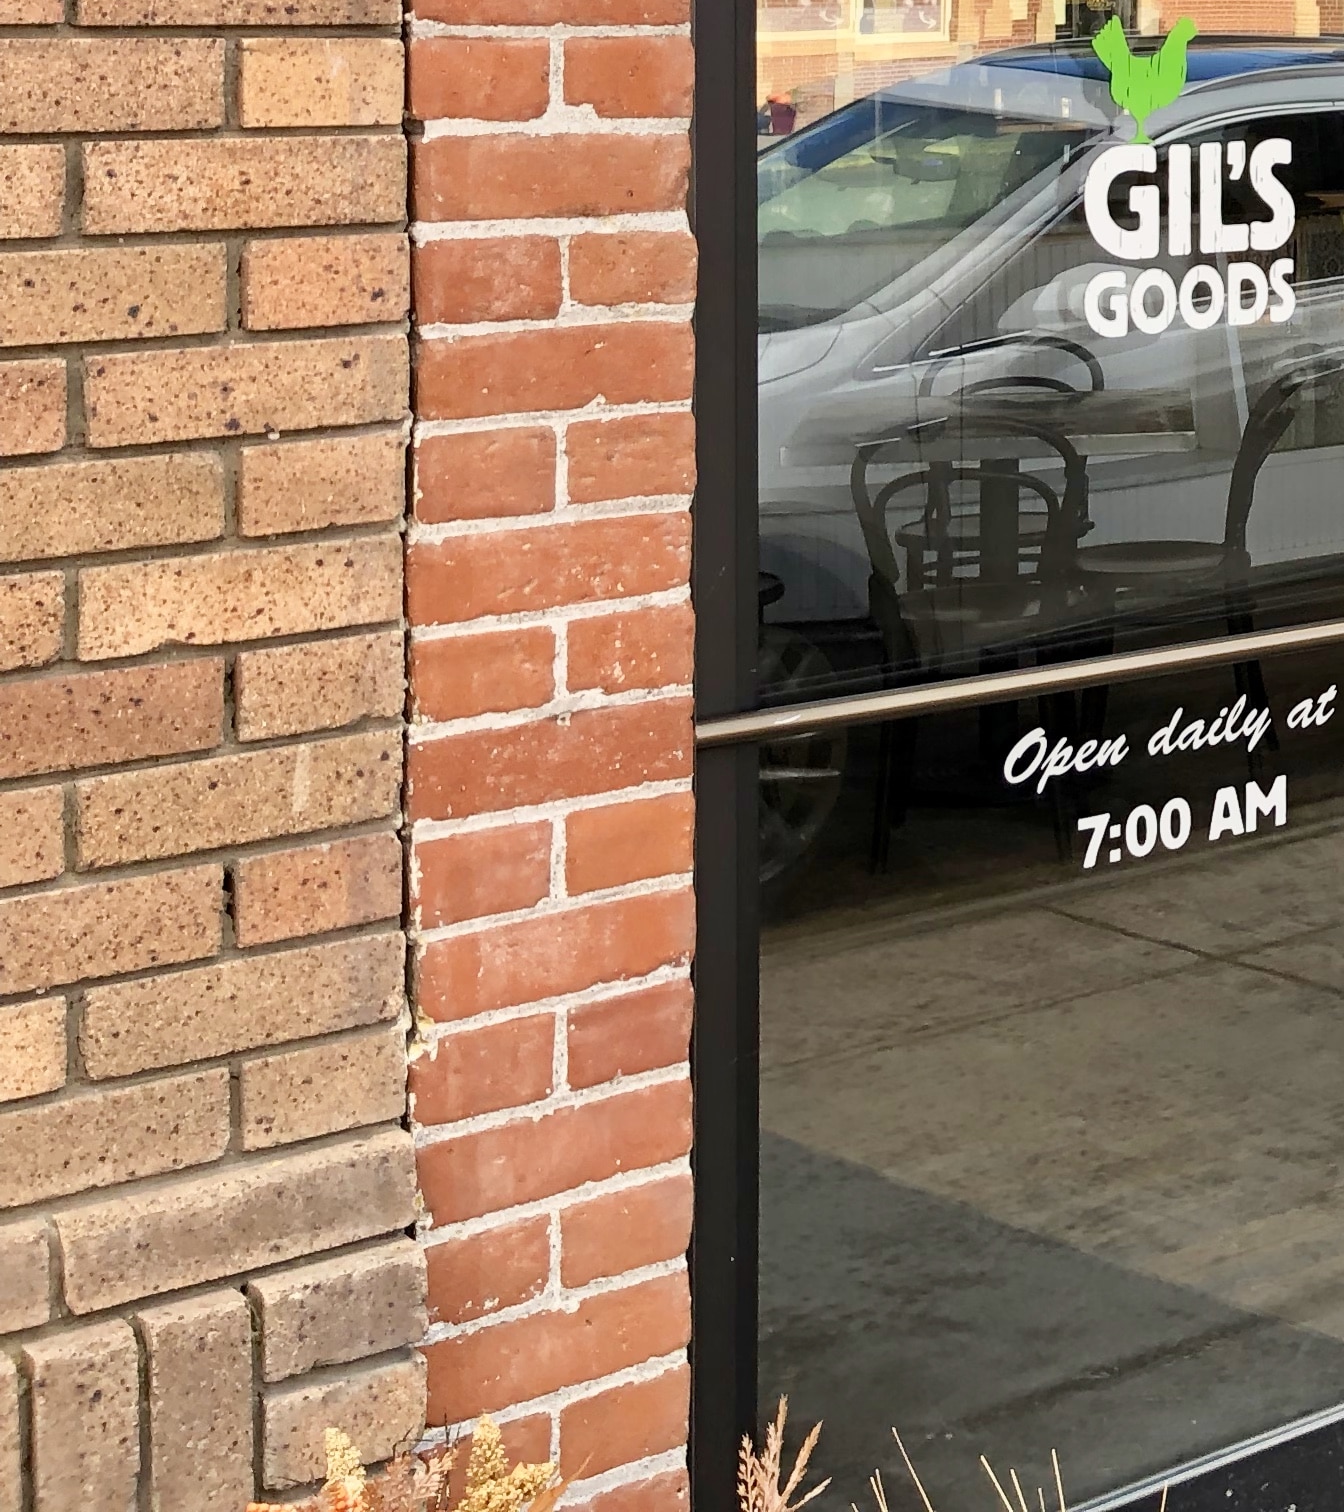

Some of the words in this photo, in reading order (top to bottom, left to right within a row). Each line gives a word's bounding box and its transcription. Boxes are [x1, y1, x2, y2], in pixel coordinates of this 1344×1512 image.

[1083, 138, 1296, 260] GIL'S
[1083, 258, 1298, 338] GOODS
[1003, 726, 1130, 795] Open
[1147, 693, 1272, 756] daily
[1286, 684, 1338, 729] at
[1077, 797, 1192, 869] 7:00
[1208, 774, 1287, 841] AM
